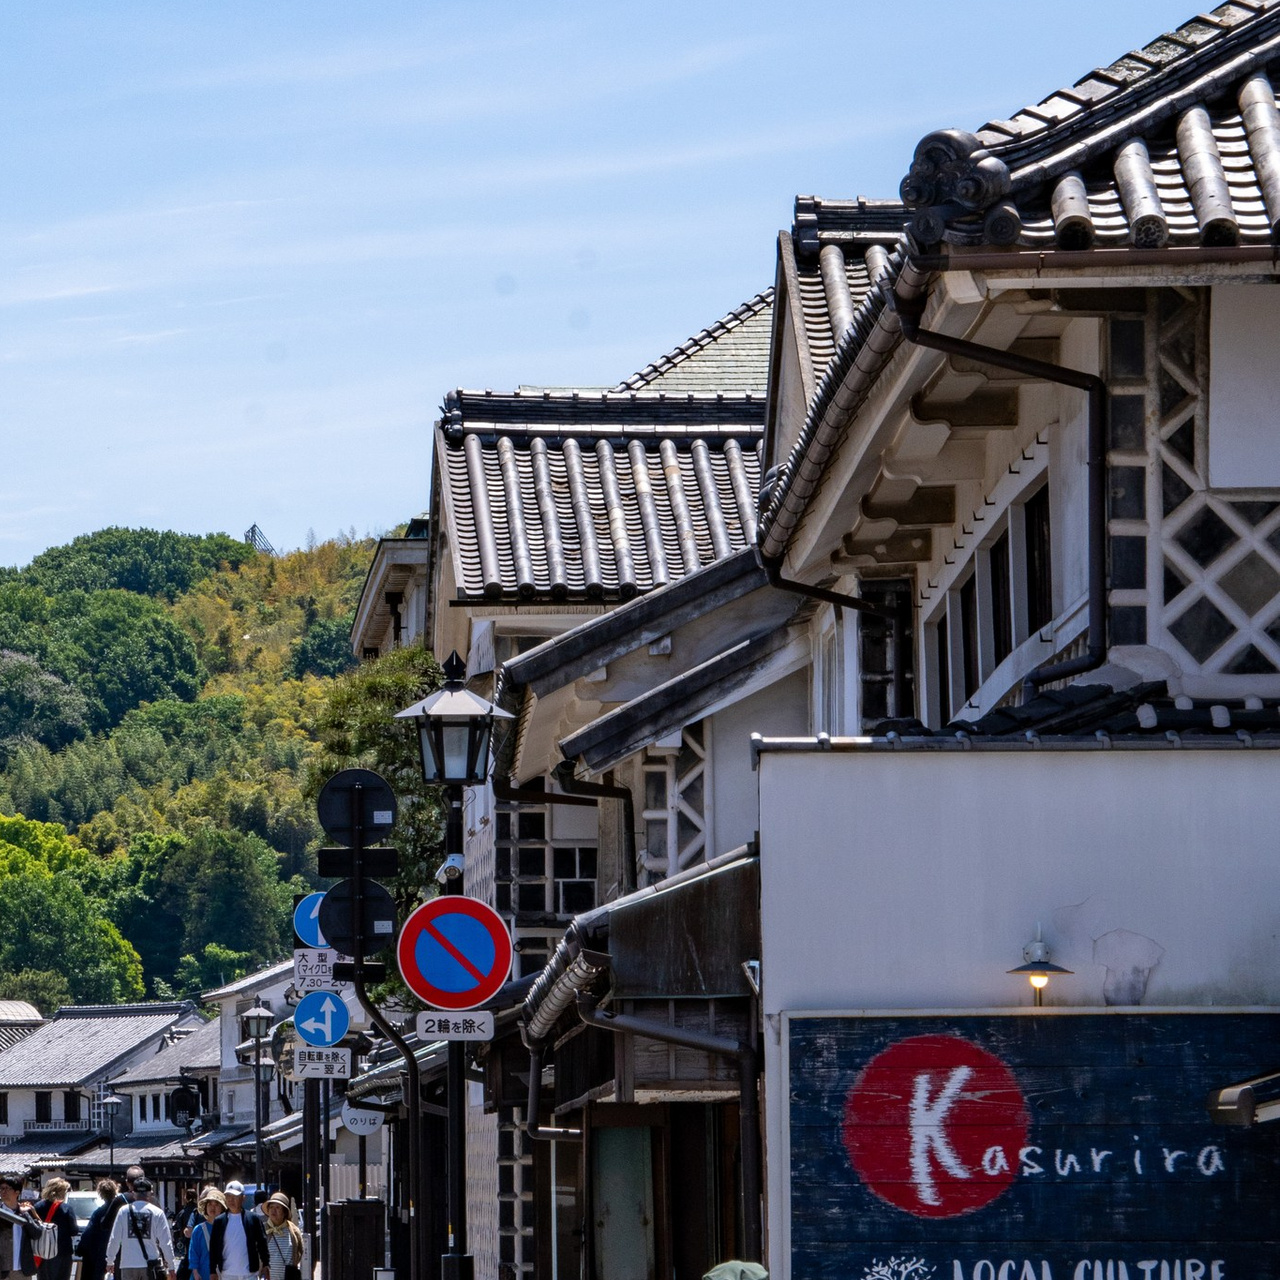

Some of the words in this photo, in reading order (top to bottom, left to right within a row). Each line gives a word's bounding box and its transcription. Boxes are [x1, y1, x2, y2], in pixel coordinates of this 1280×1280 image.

[425, 1019, 485, 1034] 2輪を除く
[298, 1051, 346, 1062] 自転車を除く
[350, 1116, 379, 1126] のりば
